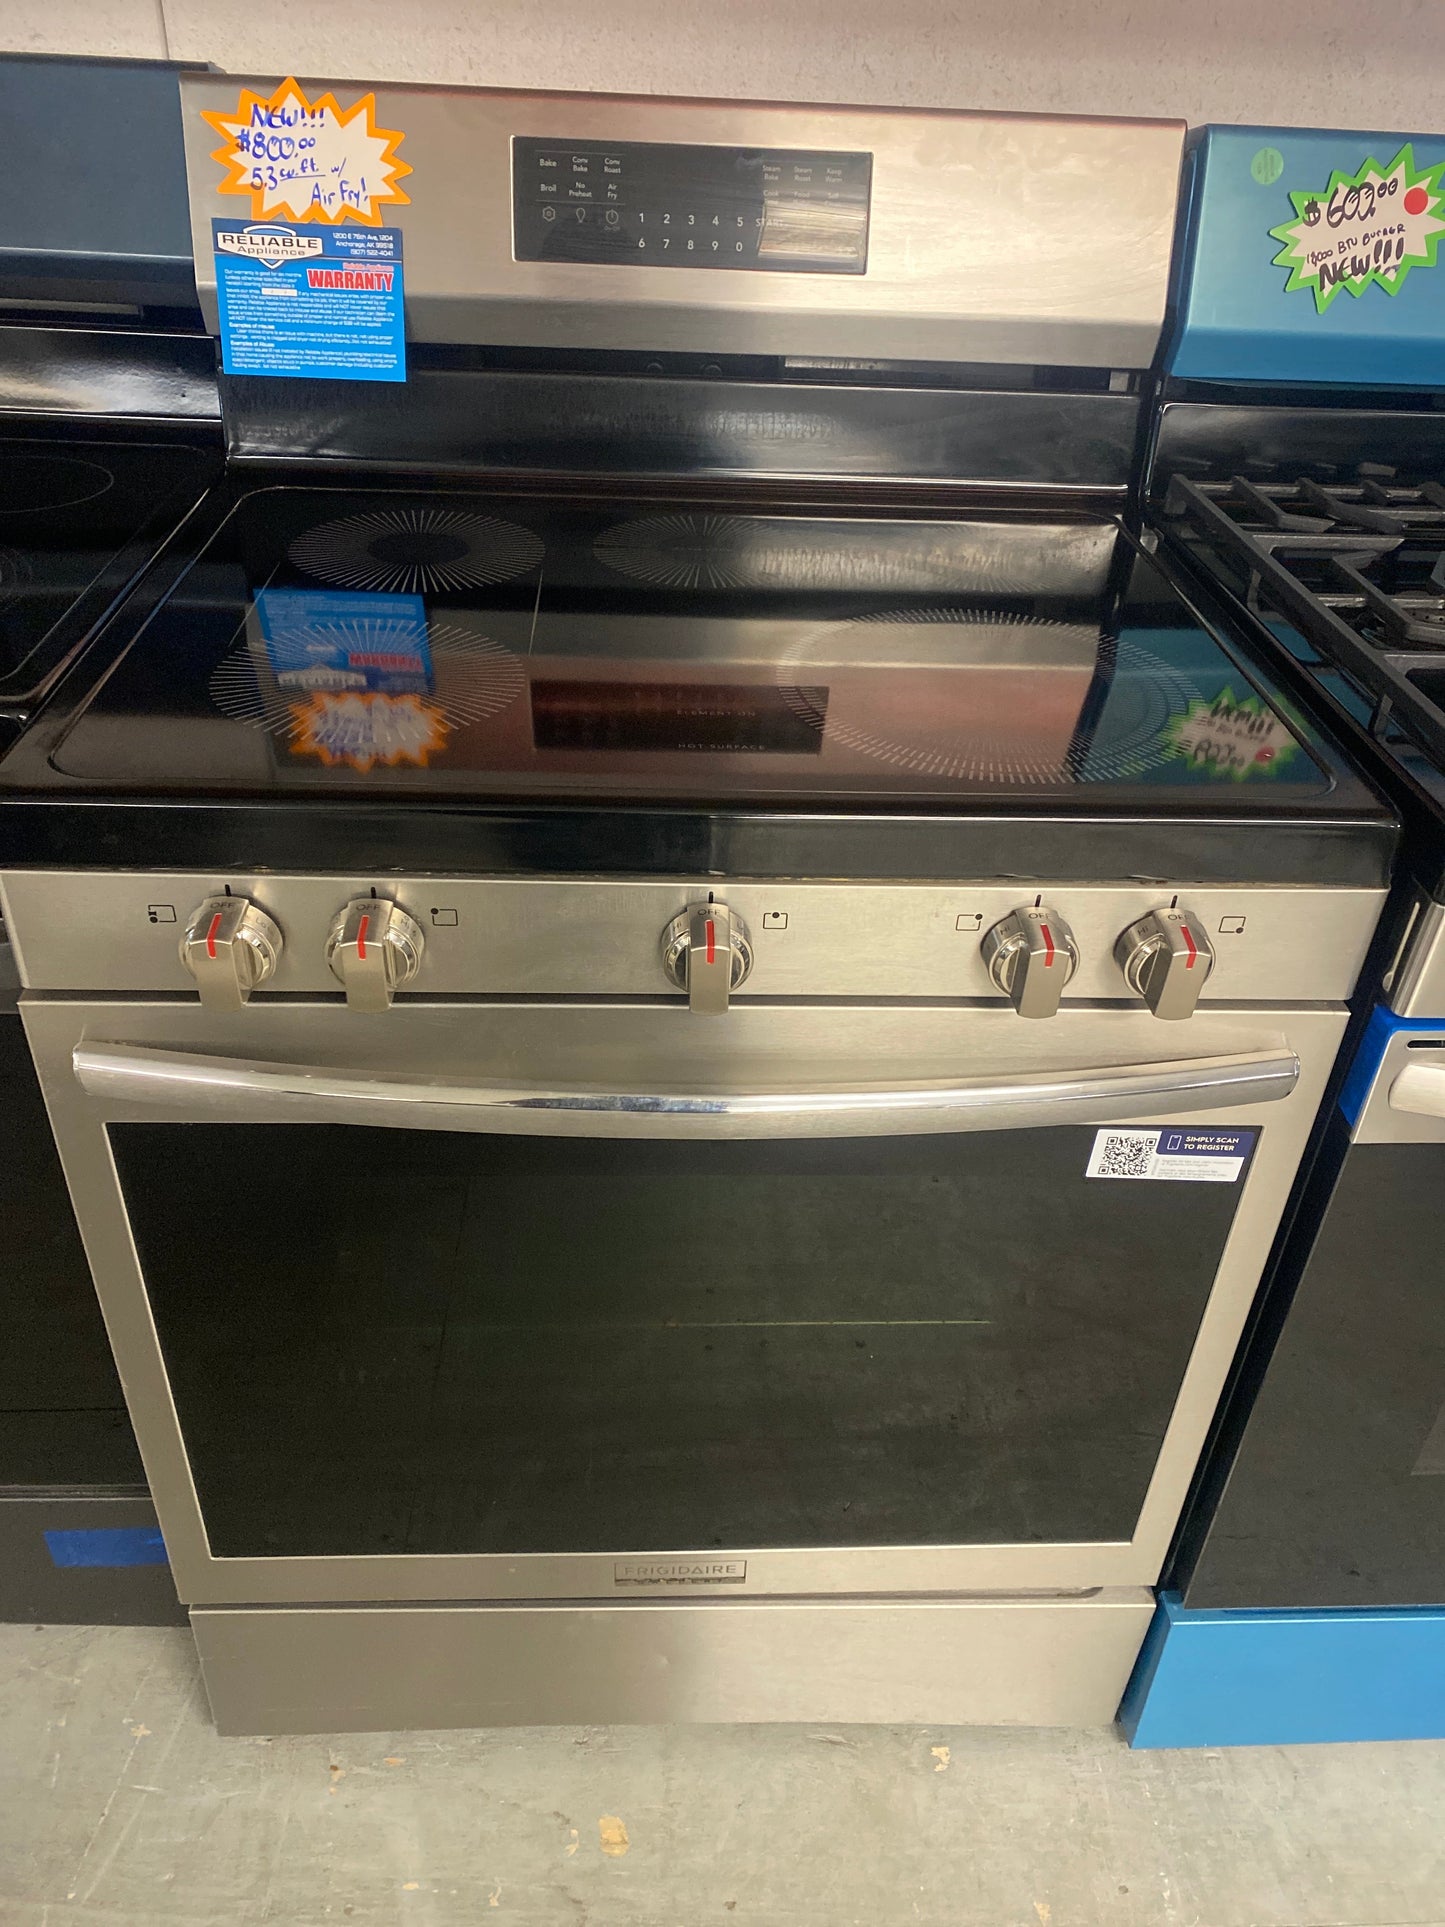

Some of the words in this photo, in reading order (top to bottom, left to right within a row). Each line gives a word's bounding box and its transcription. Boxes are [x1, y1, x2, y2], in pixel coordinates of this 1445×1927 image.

[250, 103, 325, 128] NEW!!!
[539, 158, 557, 167] Bake
[572, 156, 588, 164] Conv
[604, 158, 620, 166] Conv
[572, 165, 588, 173] Bake
[604, 166, 621, 174] Roast
[540, 184, 557, 193] Broil
[608, 183, 617, 191] Air
[311, 182, 335, 206] Air
[568, 190, 592, 198] Preheat
[607, 191, 617, 200] Fry
[639, 212, 644, 223] 1
[663, 213, 671, 224] 2
[688, 215, 695, 225] 3
[712, 216, 719, 226] 4
[737, 217, 744, 227] 5
[222, 234, 319, 249] RELIABLE
[638, 238, 646, 248] 6
[663, 239, 670, 249] 7
[687, 240, 694, 250] 8
[711, 241, 719, 251] 9
[736, 242, 743, 252] 0
[237, 245, 306, 256] Appliance
[1318, 237, 1405, 292] NEW!!!
[307, 268, 394, 292] WARRANTY
[209, 901, 235, 909] OFF
[356, 903, 382, 911] OFF
[697, 908, 721, 916] OFF
[1028, 912, 1051, 920] OFF
[1167, 913, 1191, 921] OFF
[1185, 1135, 1216, 1144] SIMPLY
[624, 1564, 737, 1576] FRIGIDAIRE
